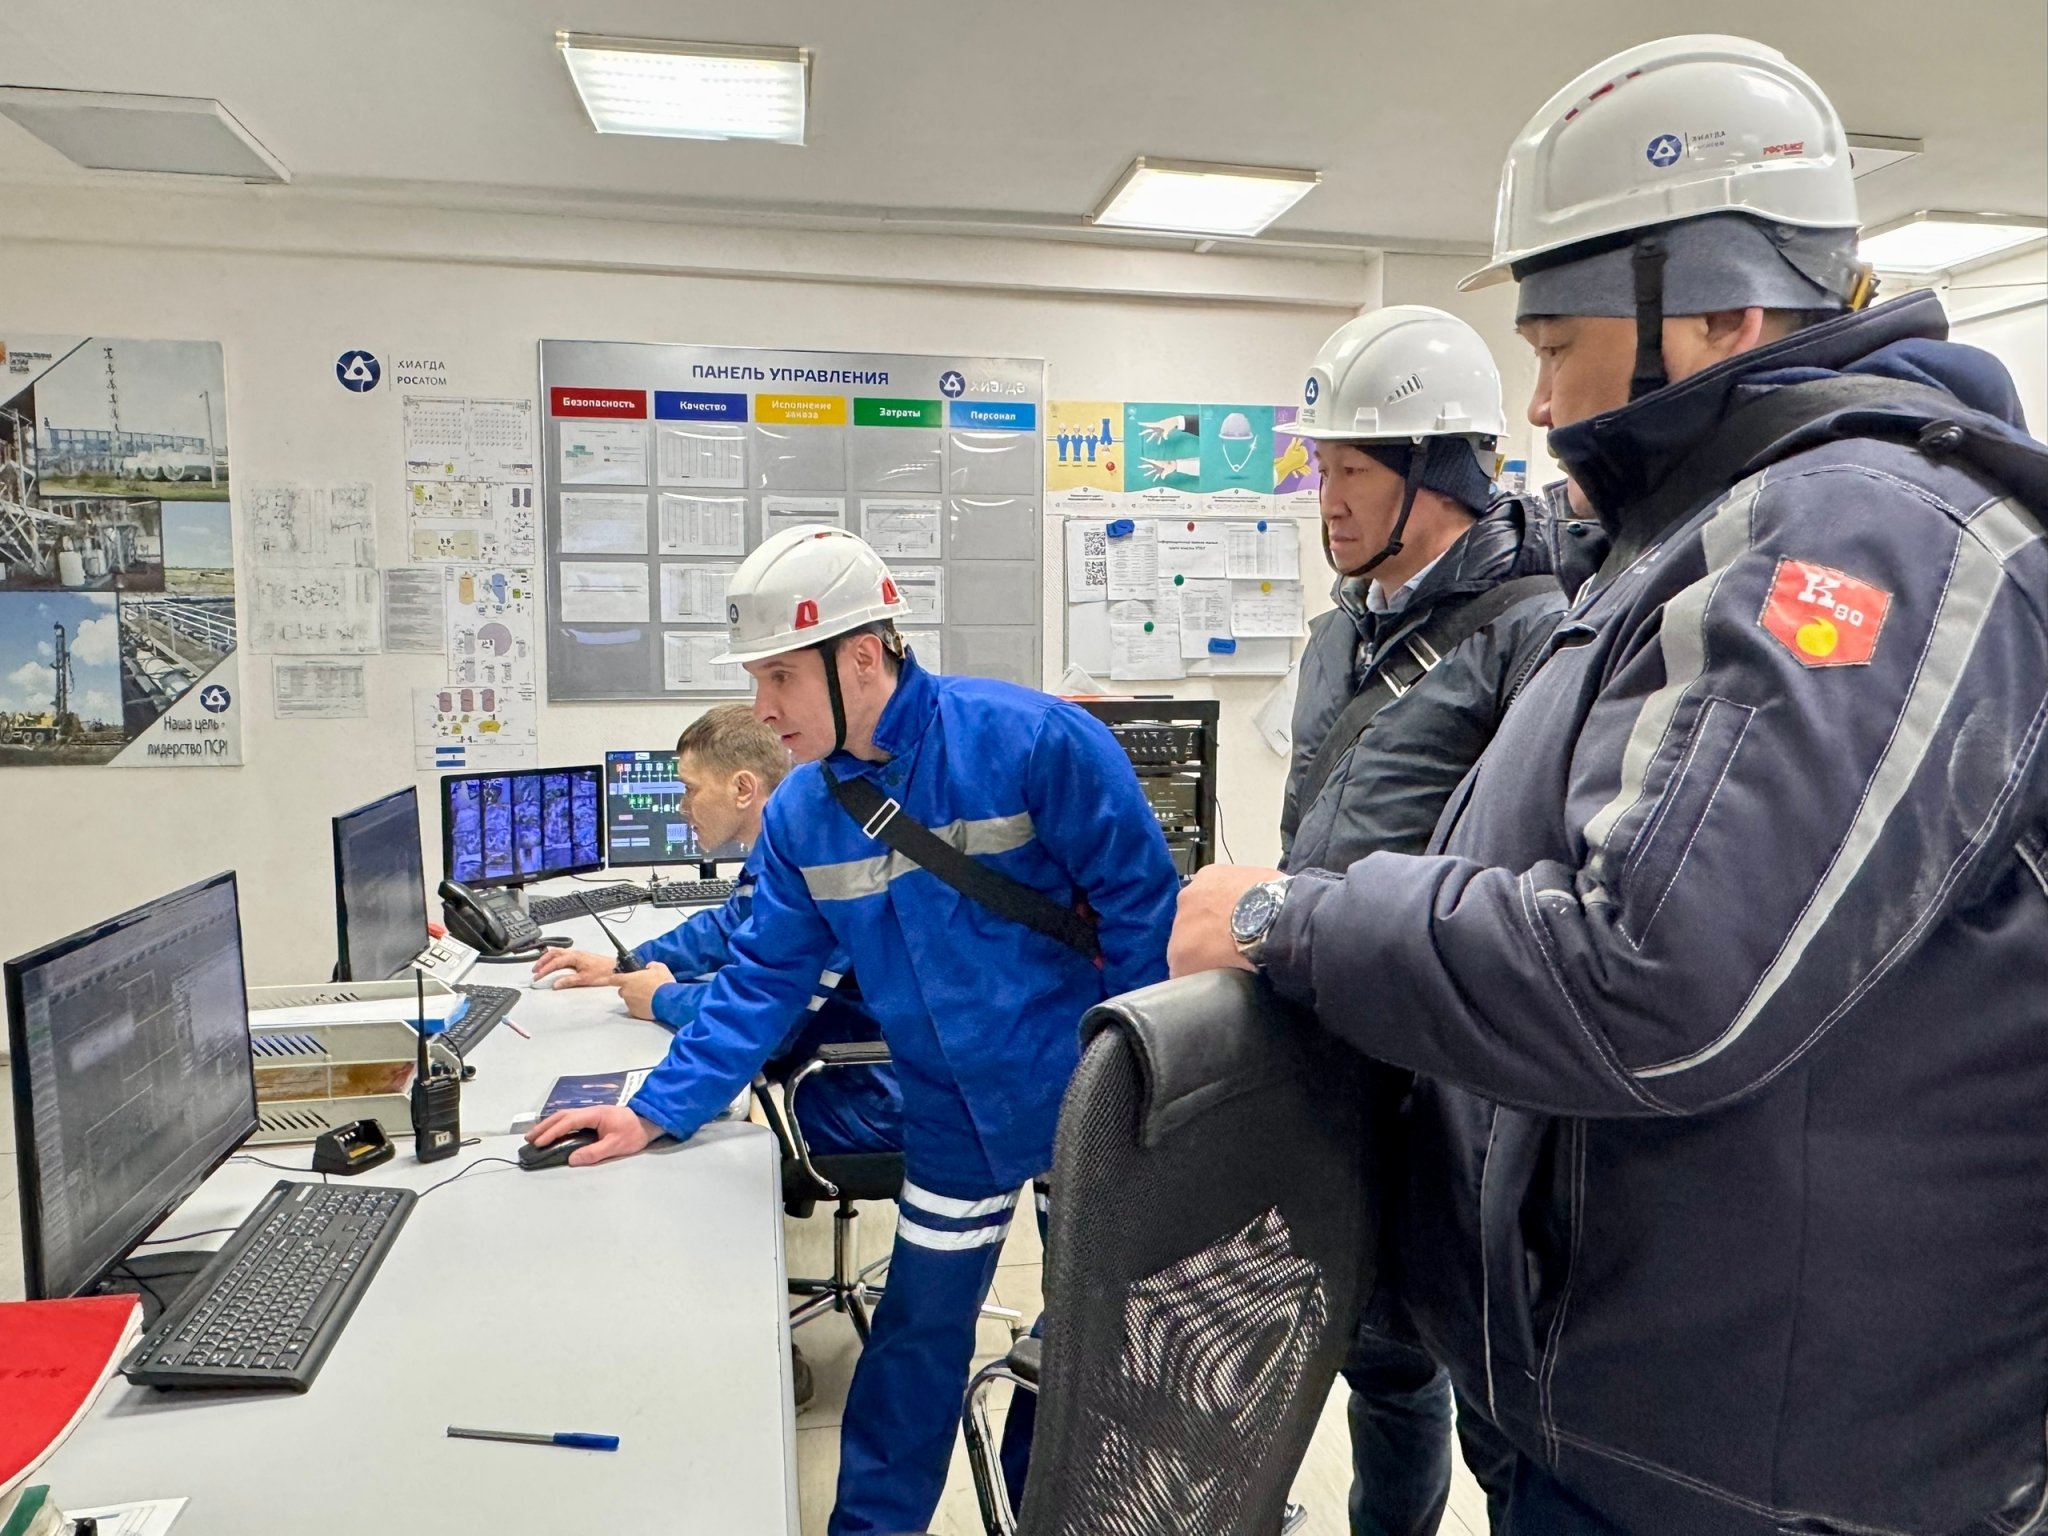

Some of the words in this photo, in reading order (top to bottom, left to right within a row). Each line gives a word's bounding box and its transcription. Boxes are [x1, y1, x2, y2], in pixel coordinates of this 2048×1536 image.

[397, 360, 446, 371] ХИАГДА
[692, 365, 765, 381] ПАНЕЛЬ
[769, 368, 889, 385] УПРАВЛЕНИЯ
[397, 376, 447, 386] РОСАТОМ
[562, 397, 636, 409] Безопасность
[680, 400, 727, 412] Качество
[771, 400, 832, 410] Исполнение
[879, 407, 921, 418] Затраты
[970, 411, 1017, 421] Персонал
[163, 716, 192, 731] Наша
[194, 719, 219, 734] цель
[147, 743, 202, 758] лидерство
